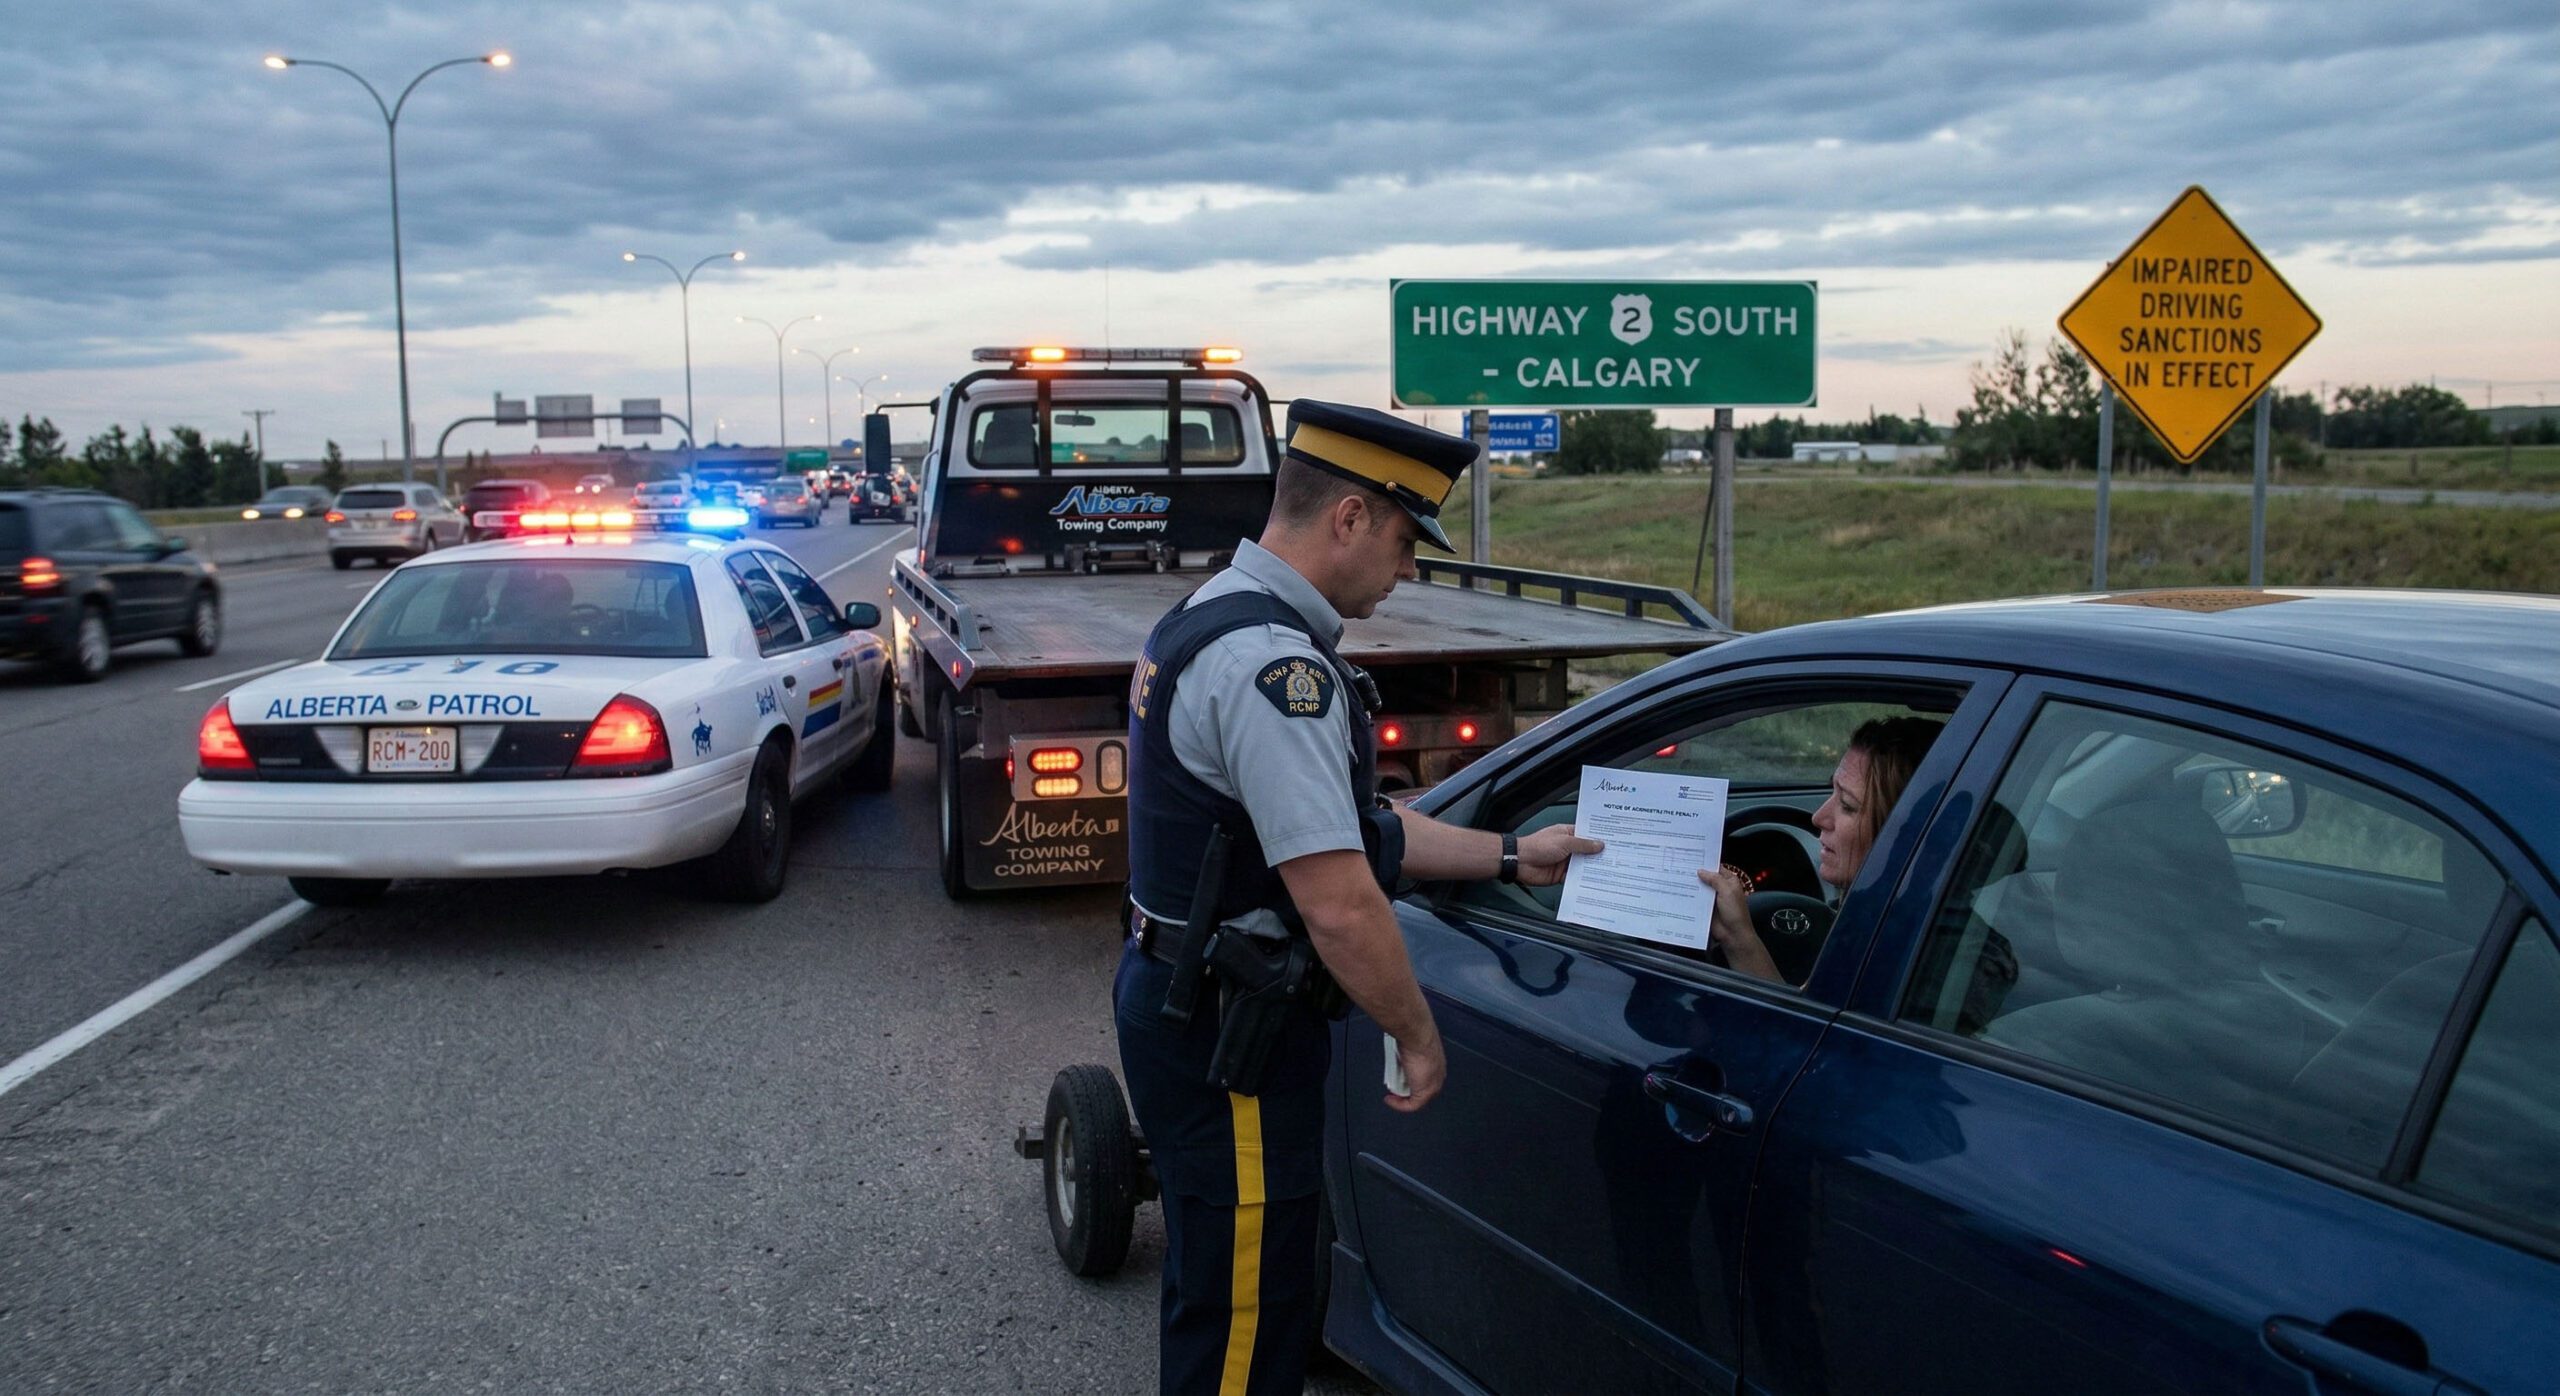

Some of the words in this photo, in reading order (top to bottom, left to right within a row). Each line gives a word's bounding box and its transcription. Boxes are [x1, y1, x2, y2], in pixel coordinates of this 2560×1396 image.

[2132, 257, 2253, 285] IMPAIRED
[2140, 292, 2243, 320] DRIVING
[1412, 305, 1588, 336] HIGHWAY
[1621, 307, 1641, 334] 2
[1673, 306, 1798, 337] SOUTH
[2119, 326, 2262, 354] SANCTIONS
[1516, 356, 1700, 388] CALGARY
[2125, 361, 2150, 388] IN
[2162, 361, 2255, 388] EFFECT
[1049, 485, 1171, 516] Alberta
[1056, 518, 1104, 533] Towing
[1107, 518, 1168, 533] Company
[265, 694, 388, 720] ALBERTA
[427, 693, 541, 717] PATROL
[1289, 701, 1320, 713] RCMP
[372, 740, 451, 761] RCM-200
[979, 801, 1110, 847] Alberta
[1006, 844, 1090, 861] TOWING
[994, 859, 1105, 877] COMPANY
